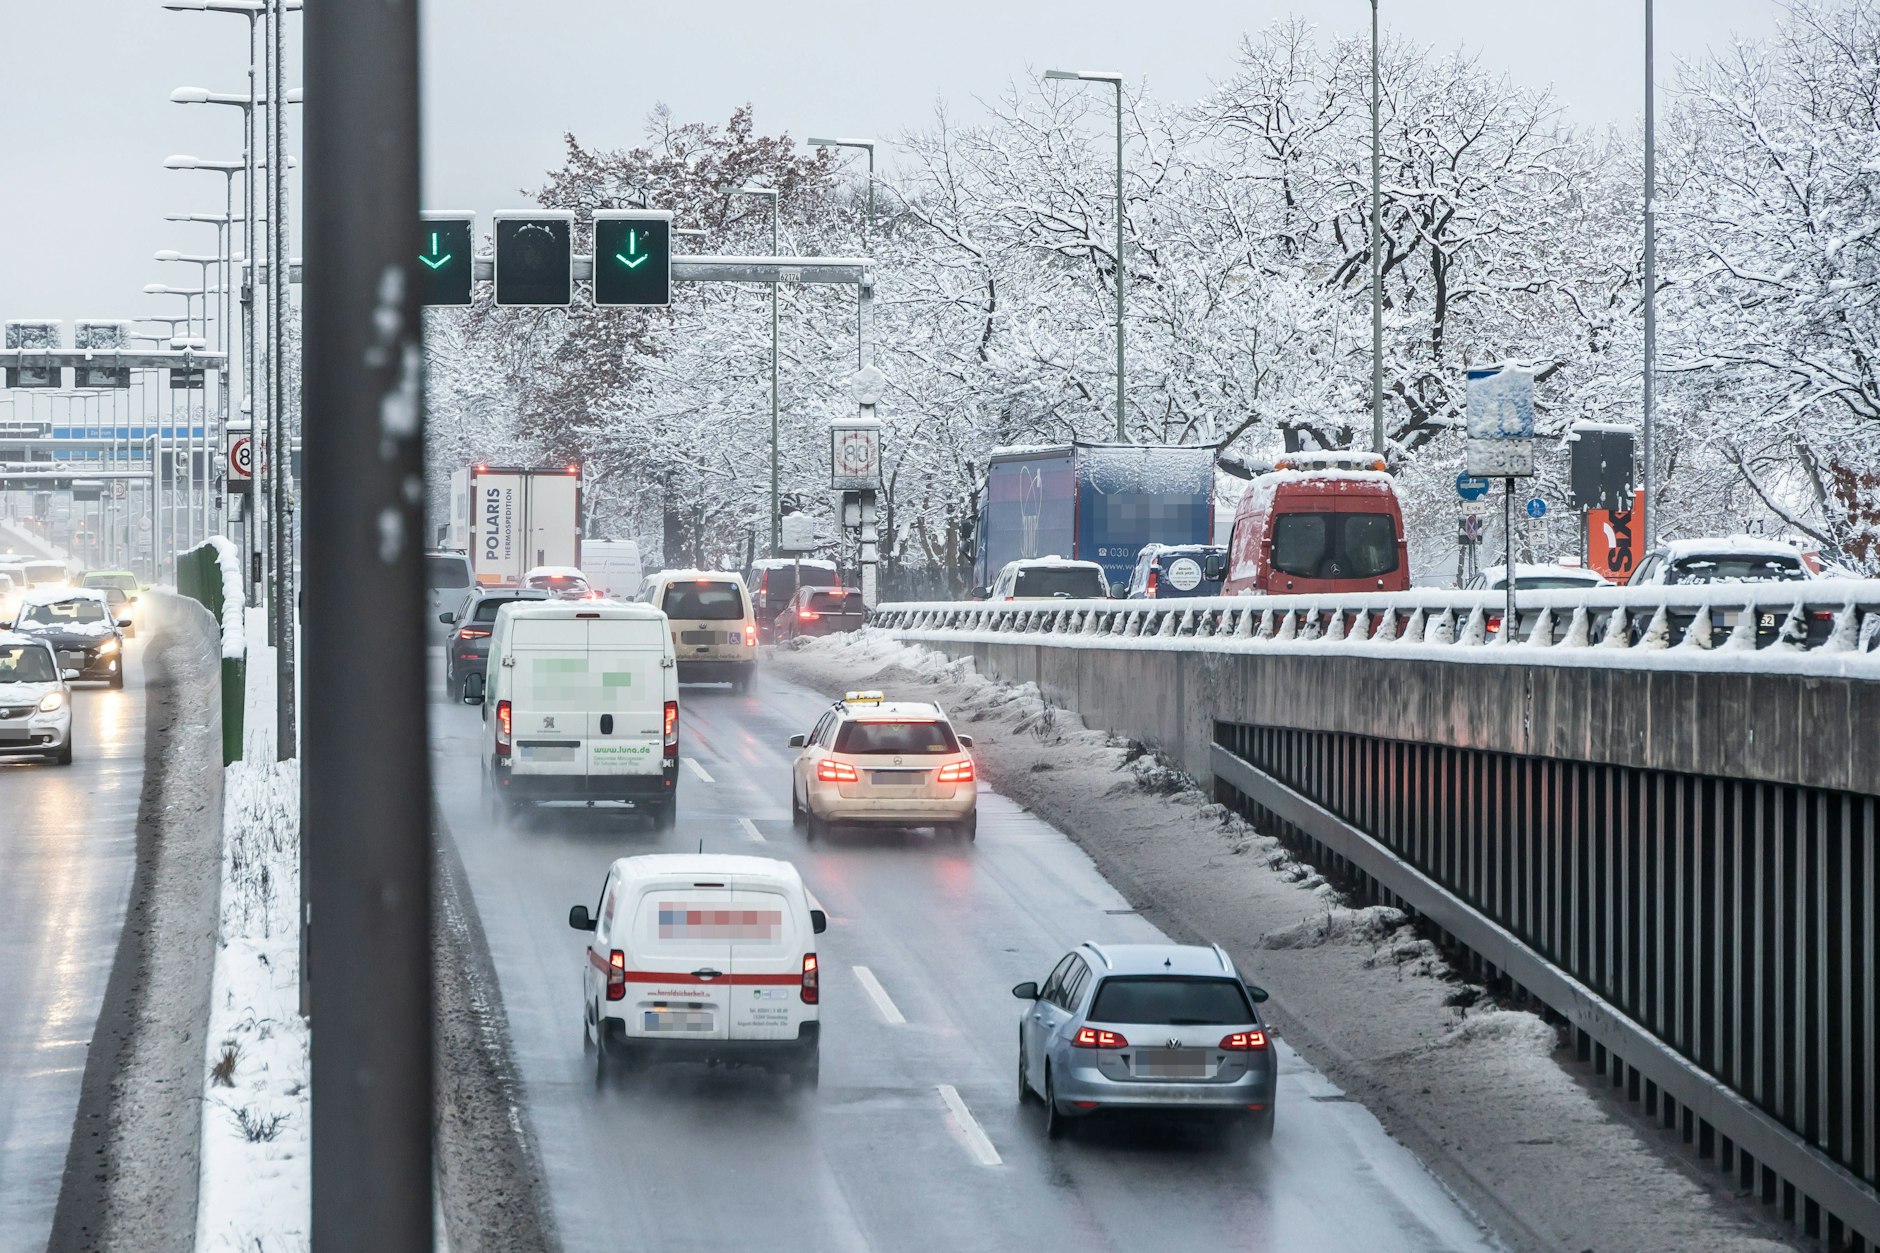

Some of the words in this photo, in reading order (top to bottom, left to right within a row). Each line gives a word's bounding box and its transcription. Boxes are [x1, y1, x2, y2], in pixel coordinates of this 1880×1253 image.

[845, 445, 868, 463] 80
[486, 488, 500, 560] POLARIS
[504, 488, 512, 560] THERMOSPEDITION
[1110, 547, 1129, 557] 030
